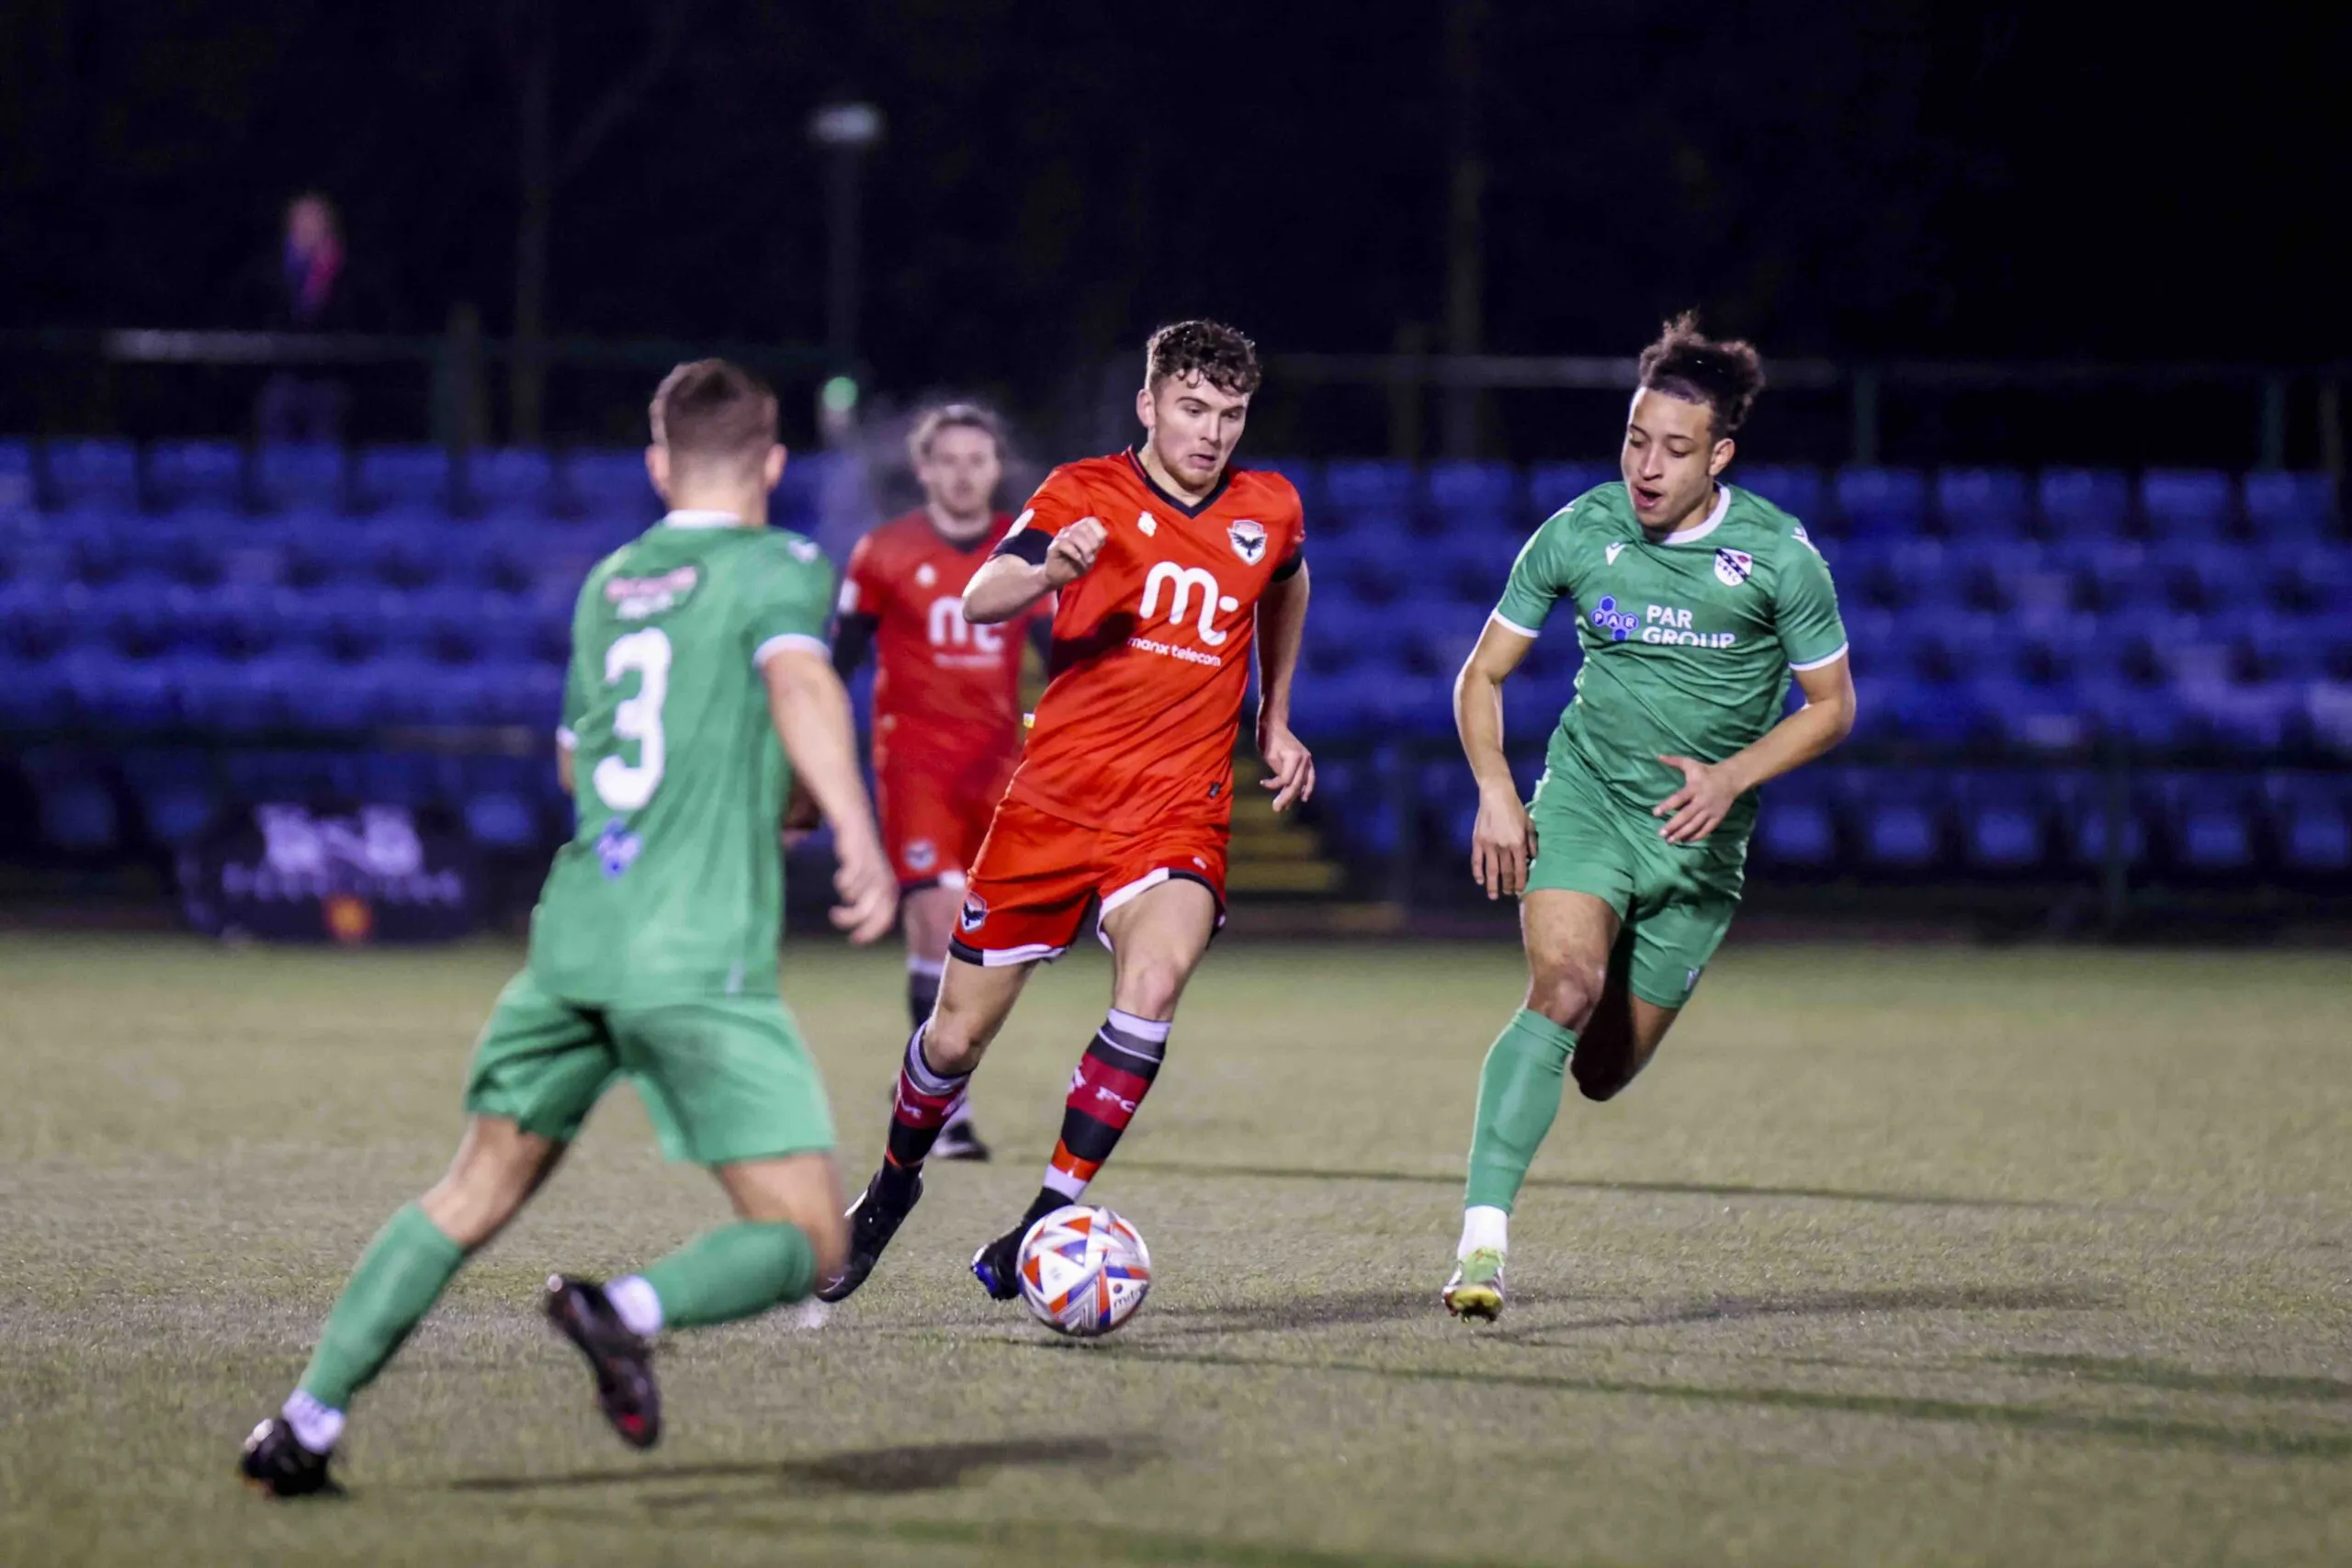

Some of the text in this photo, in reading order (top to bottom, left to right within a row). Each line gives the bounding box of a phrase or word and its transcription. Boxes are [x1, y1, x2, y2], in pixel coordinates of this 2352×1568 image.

[1646, 604, 1692, 629] PAR
[1642, 626, 1736, 649] GROUP
[1127, 637, 1222, 667] manx telecom
[593, 626, 673, 811] 3
